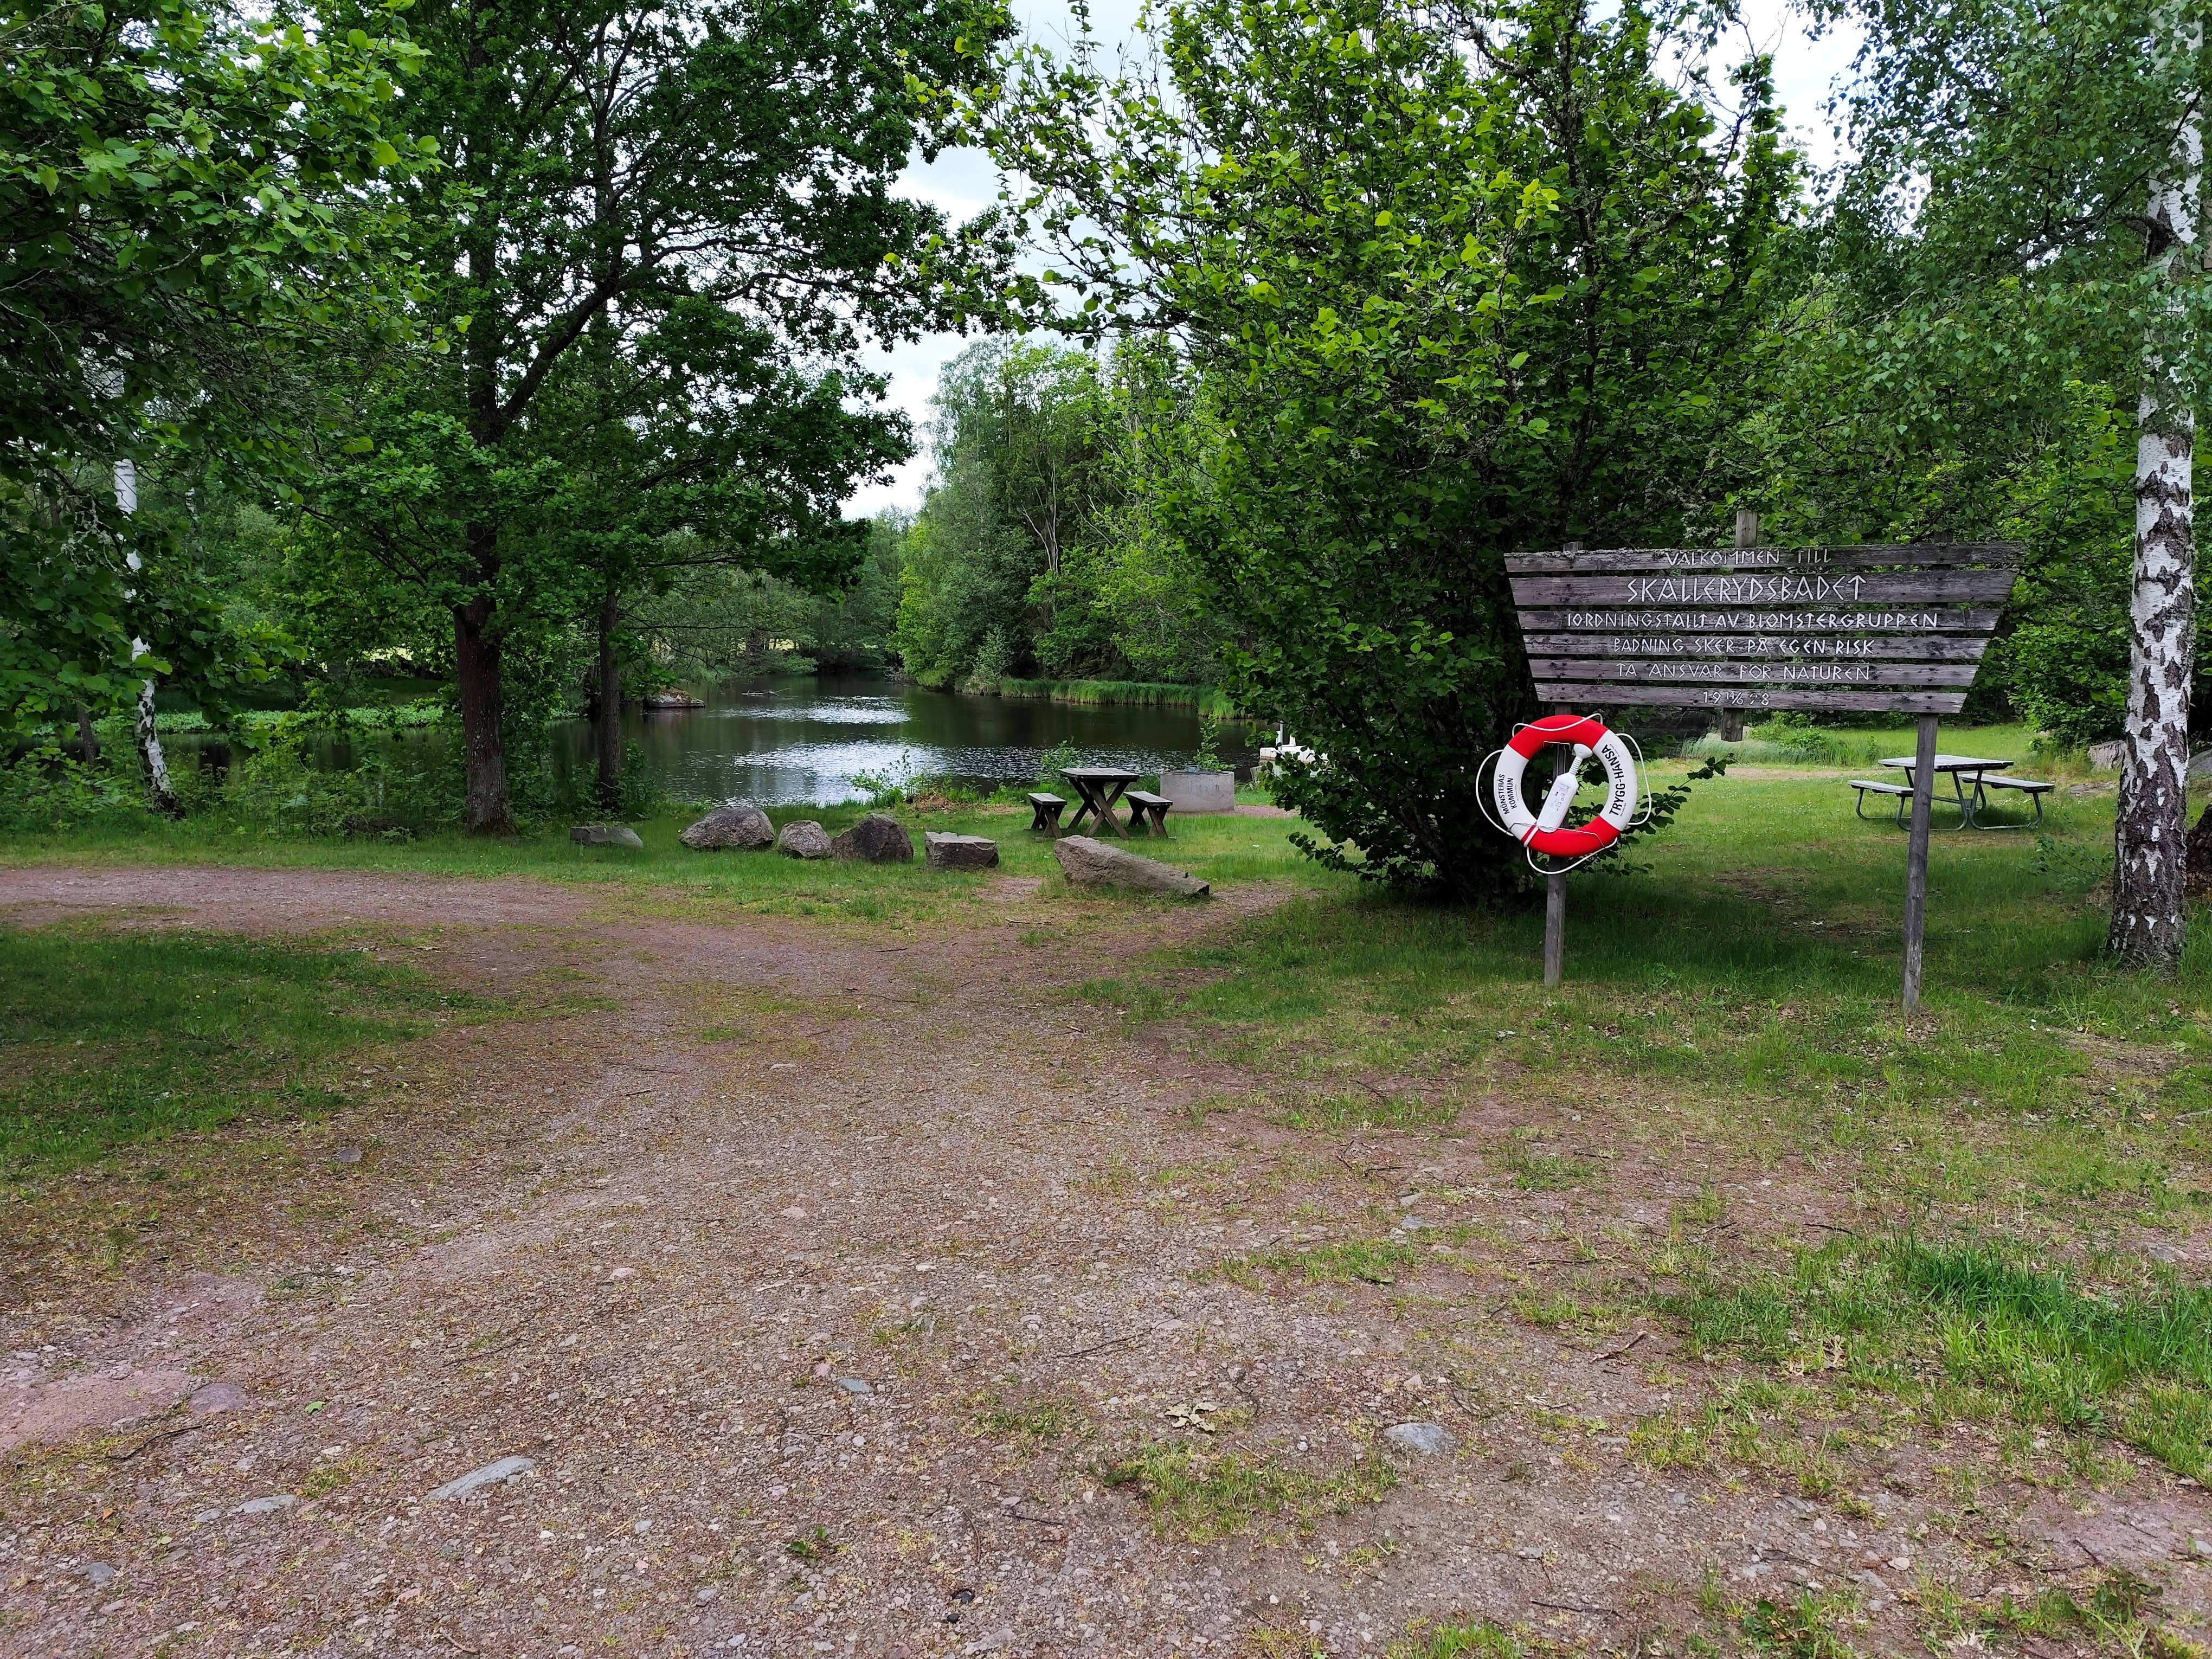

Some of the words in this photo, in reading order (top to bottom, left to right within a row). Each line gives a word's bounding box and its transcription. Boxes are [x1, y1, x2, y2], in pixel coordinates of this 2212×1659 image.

[1797, 549, 1831, 564] TILL
[1627, 575, 1866, 602] SKÄLLERYDSBADET
[1714, 613, 1739, 628] AV
[1748, 613, 1938, 628] BLOMSTERGRUPPEN
[1613, 638, 1684, 653] BADNING
[1695, 639, 1734, 653] SKER
[1747, 638, 1769, 654] PÅ
[1779, 639, 1825, 654] EGEN
[1836, 640, 1875, 655] RISK
[1616, 663, 1637, 677] TA
[1649, 664, 1722, 678] ANSVAR
[1740, 664, 1771, 679] FÖR
[1784, 665, 1870, 680] NATUREN
[1601, 744, 1625, 816] TRYGG-HANSA
[1507, 777, 1517, 809] KOMMUN
